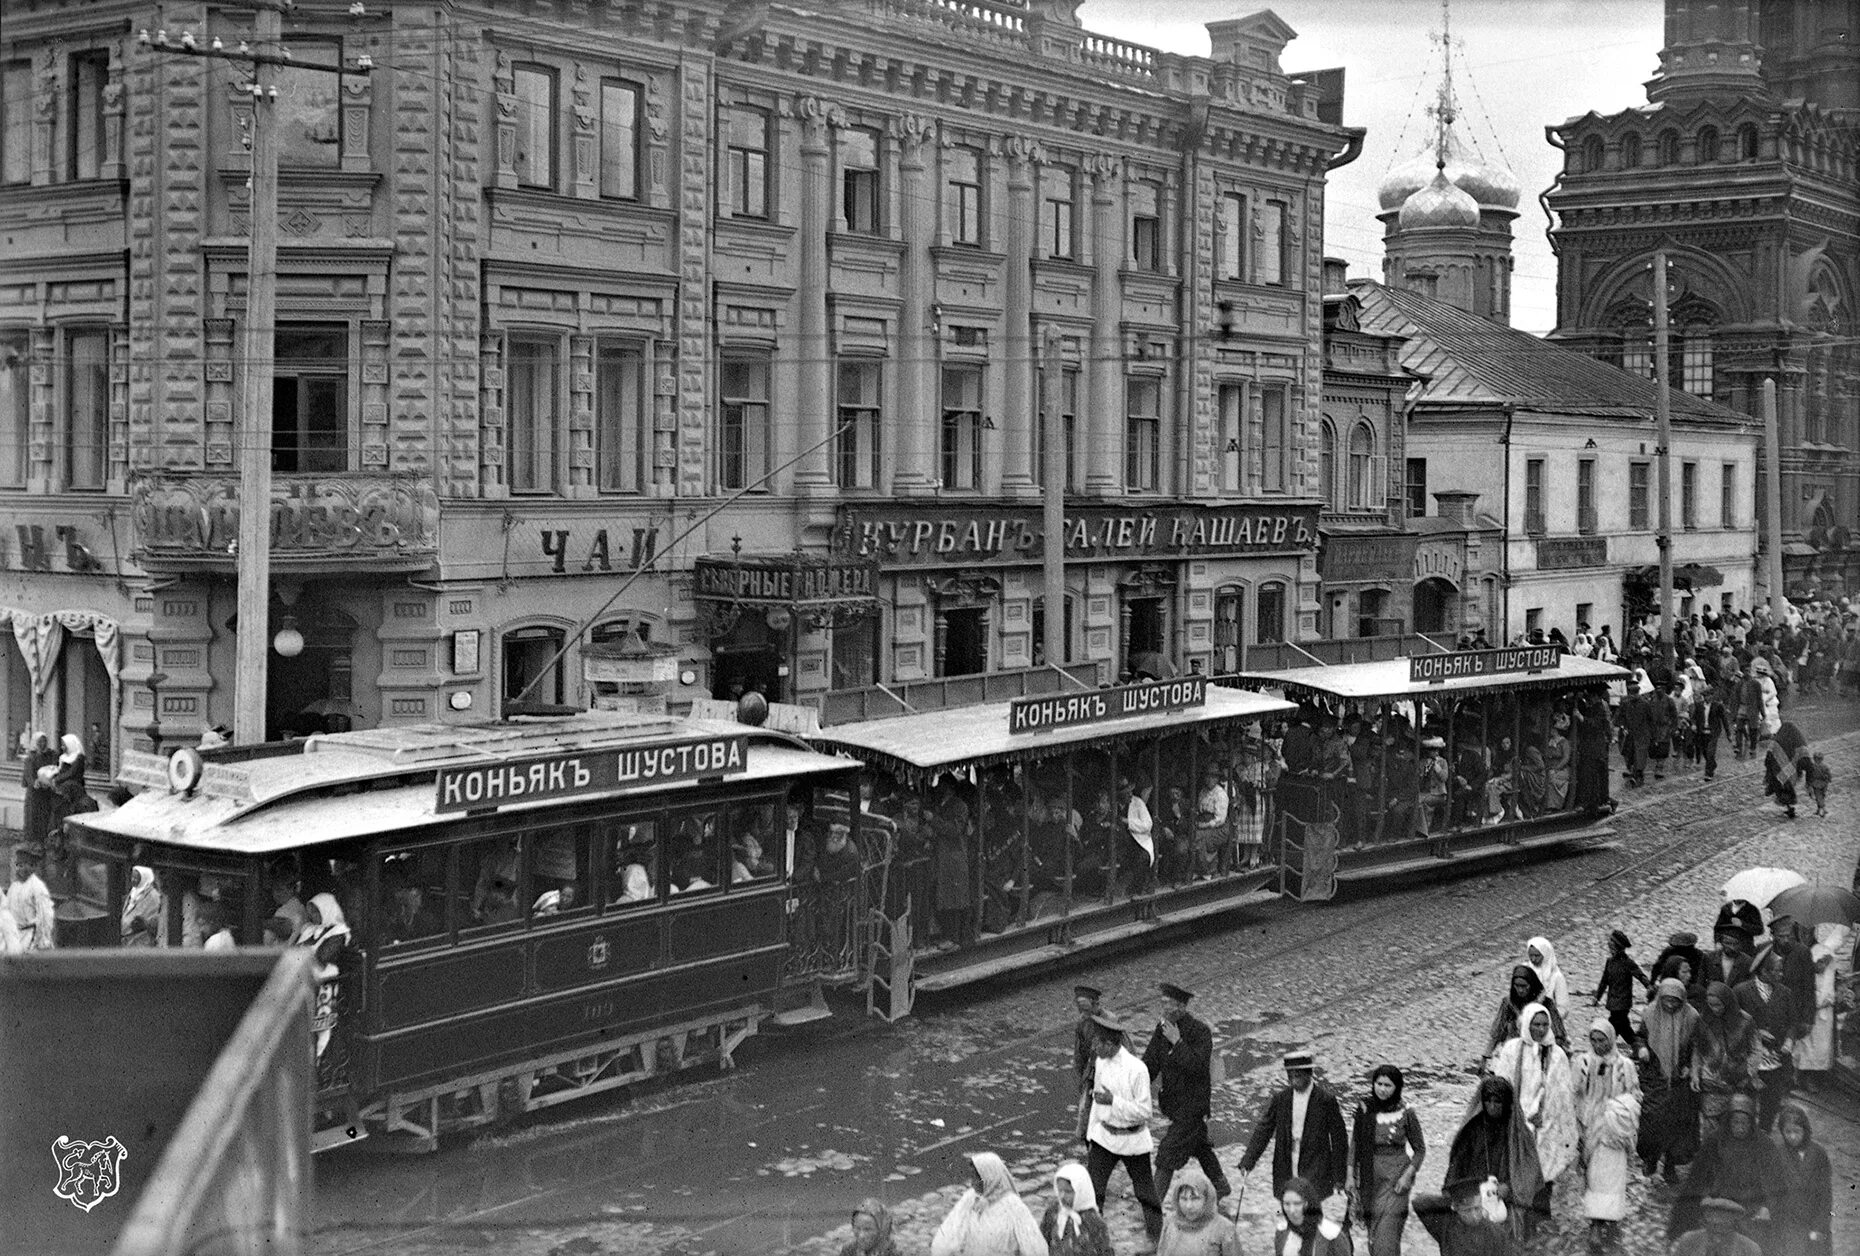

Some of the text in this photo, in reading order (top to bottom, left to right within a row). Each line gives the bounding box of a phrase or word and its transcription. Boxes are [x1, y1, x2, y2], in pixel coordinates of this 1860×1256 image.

[1496, 648, 1557, 671] ШУСТОВА
[1015, 680, 1202, 729] КОНЬЯКЪ ШУСТОВА
[443, 739, 742, 805] КОНЬЯКЪ ШУСТОВА
